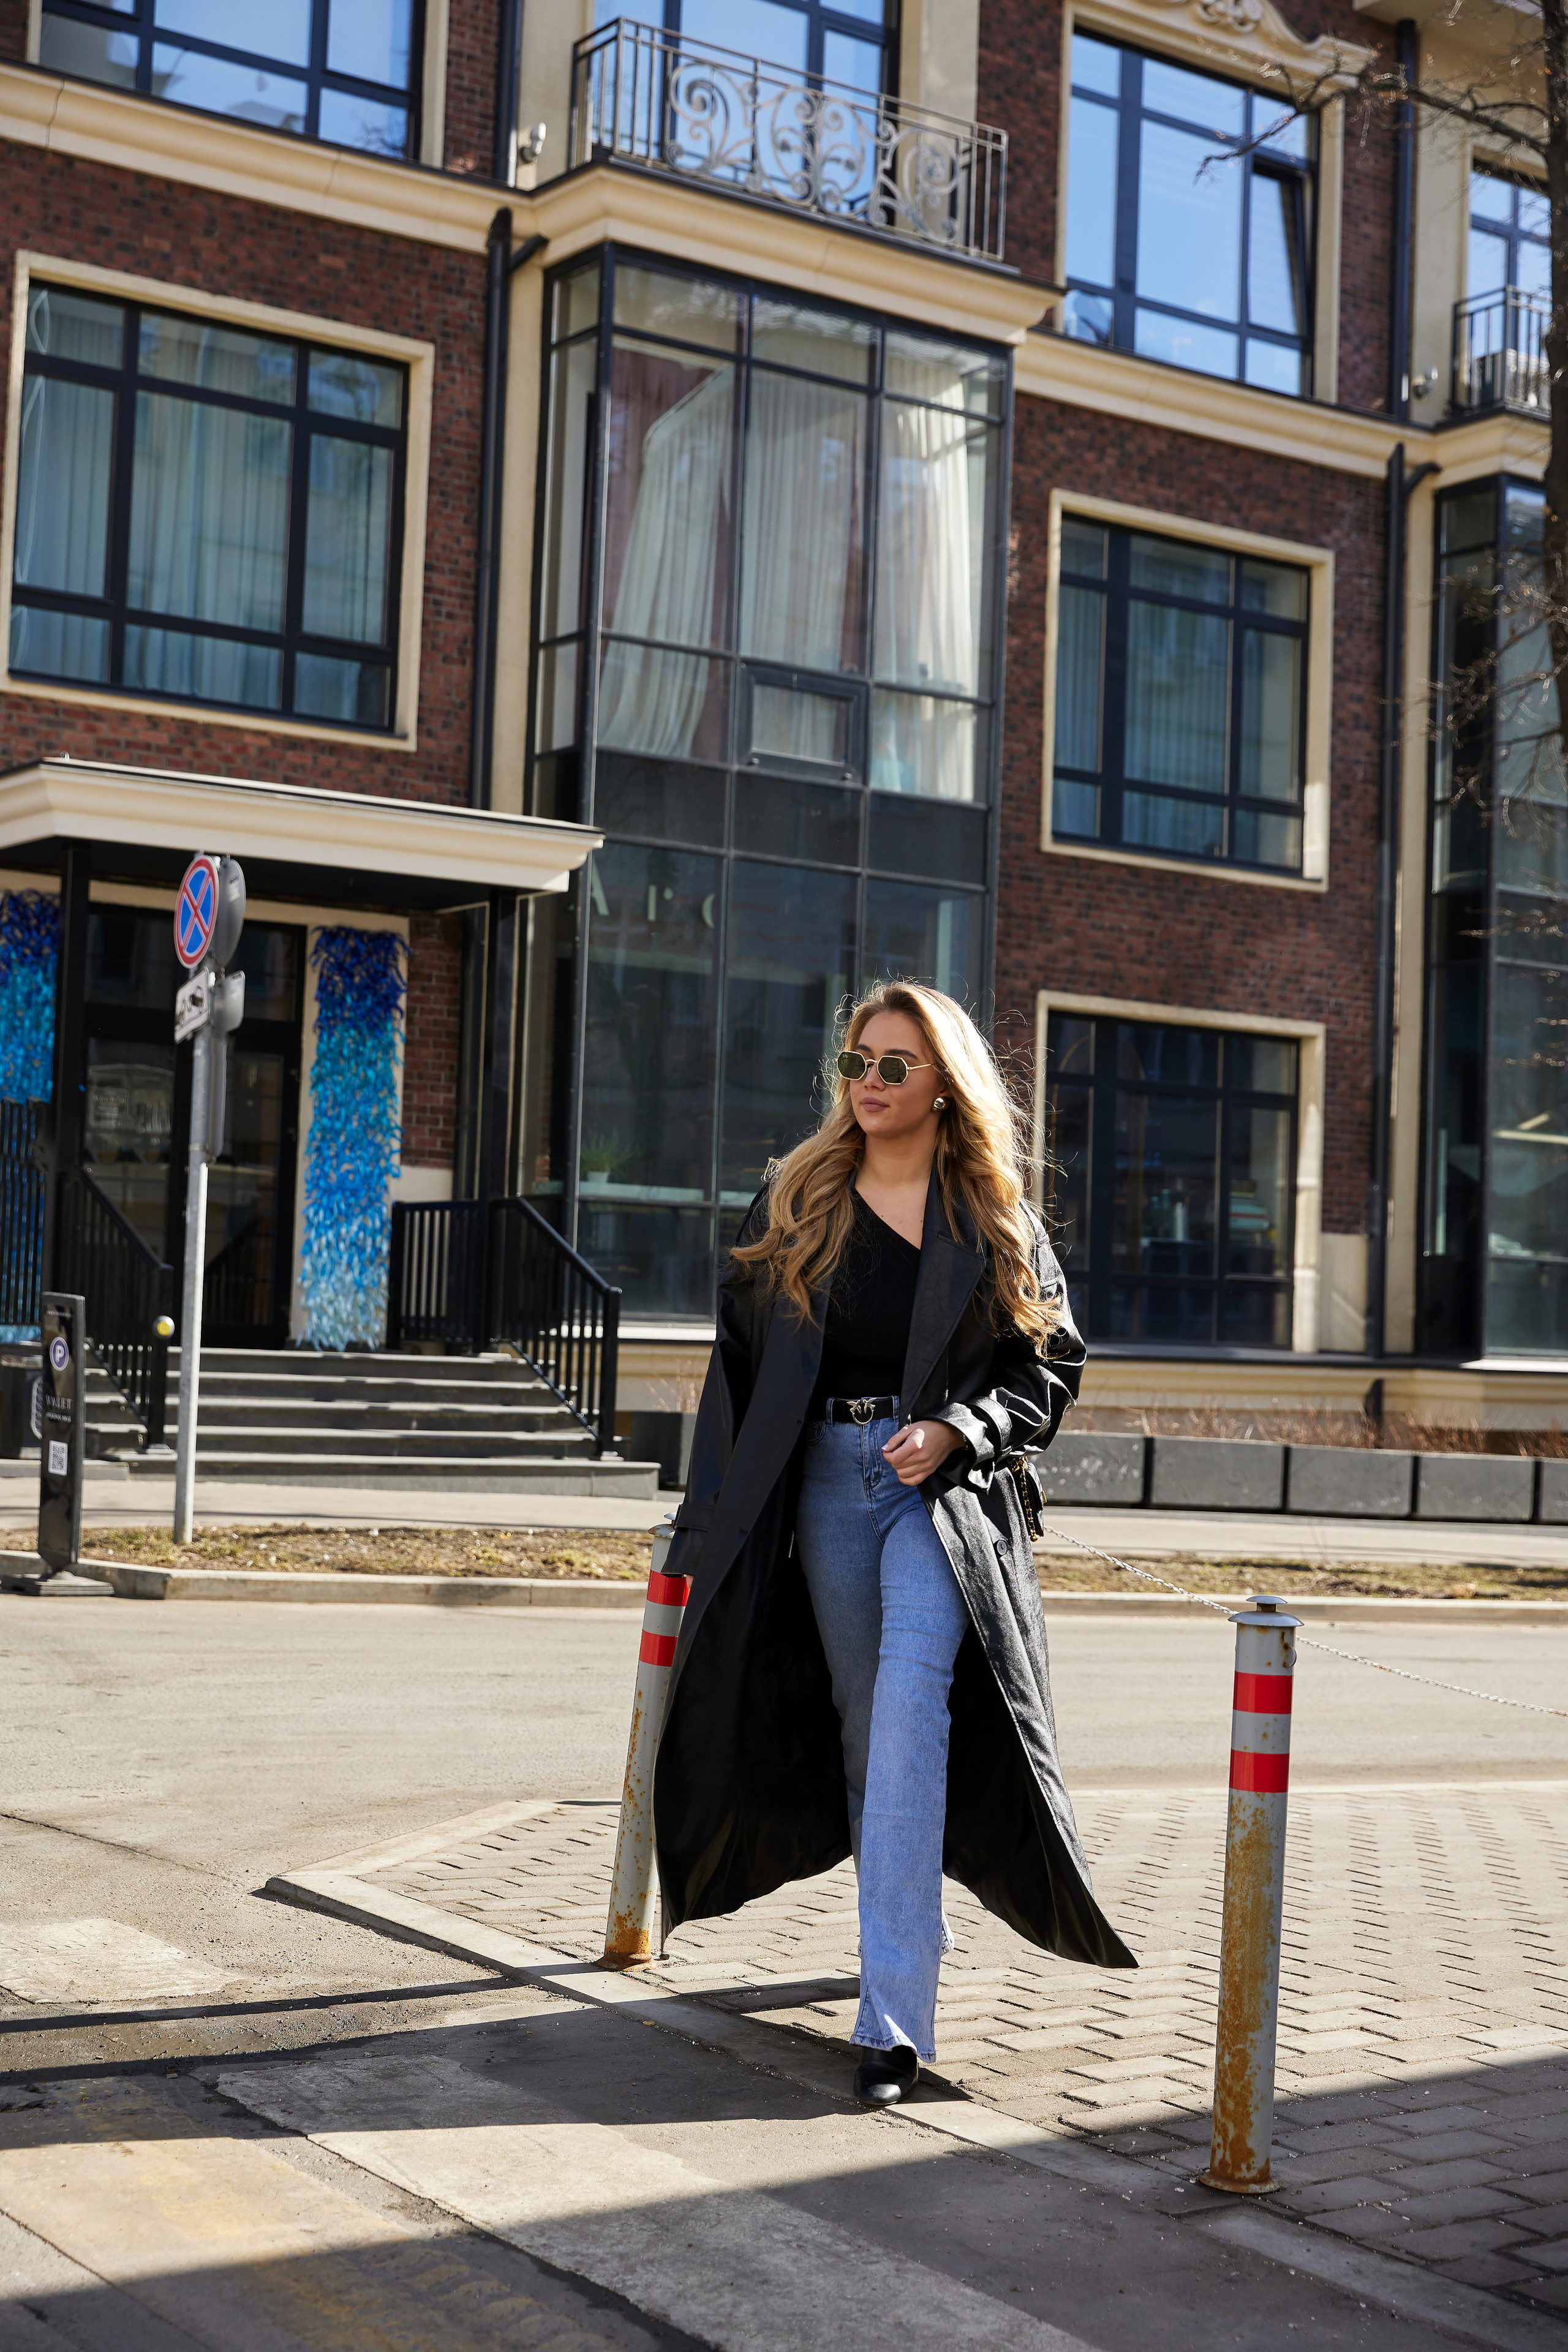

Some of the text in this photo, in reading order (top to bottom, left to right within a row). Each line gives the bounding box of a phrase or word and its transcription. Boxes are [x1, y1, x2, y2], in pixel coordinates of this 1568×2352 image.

[55, 1344, 65, 1363] P
[45, 1395, 72, 1410] VALET
[45, 1411, 72, 1423] PARKING
